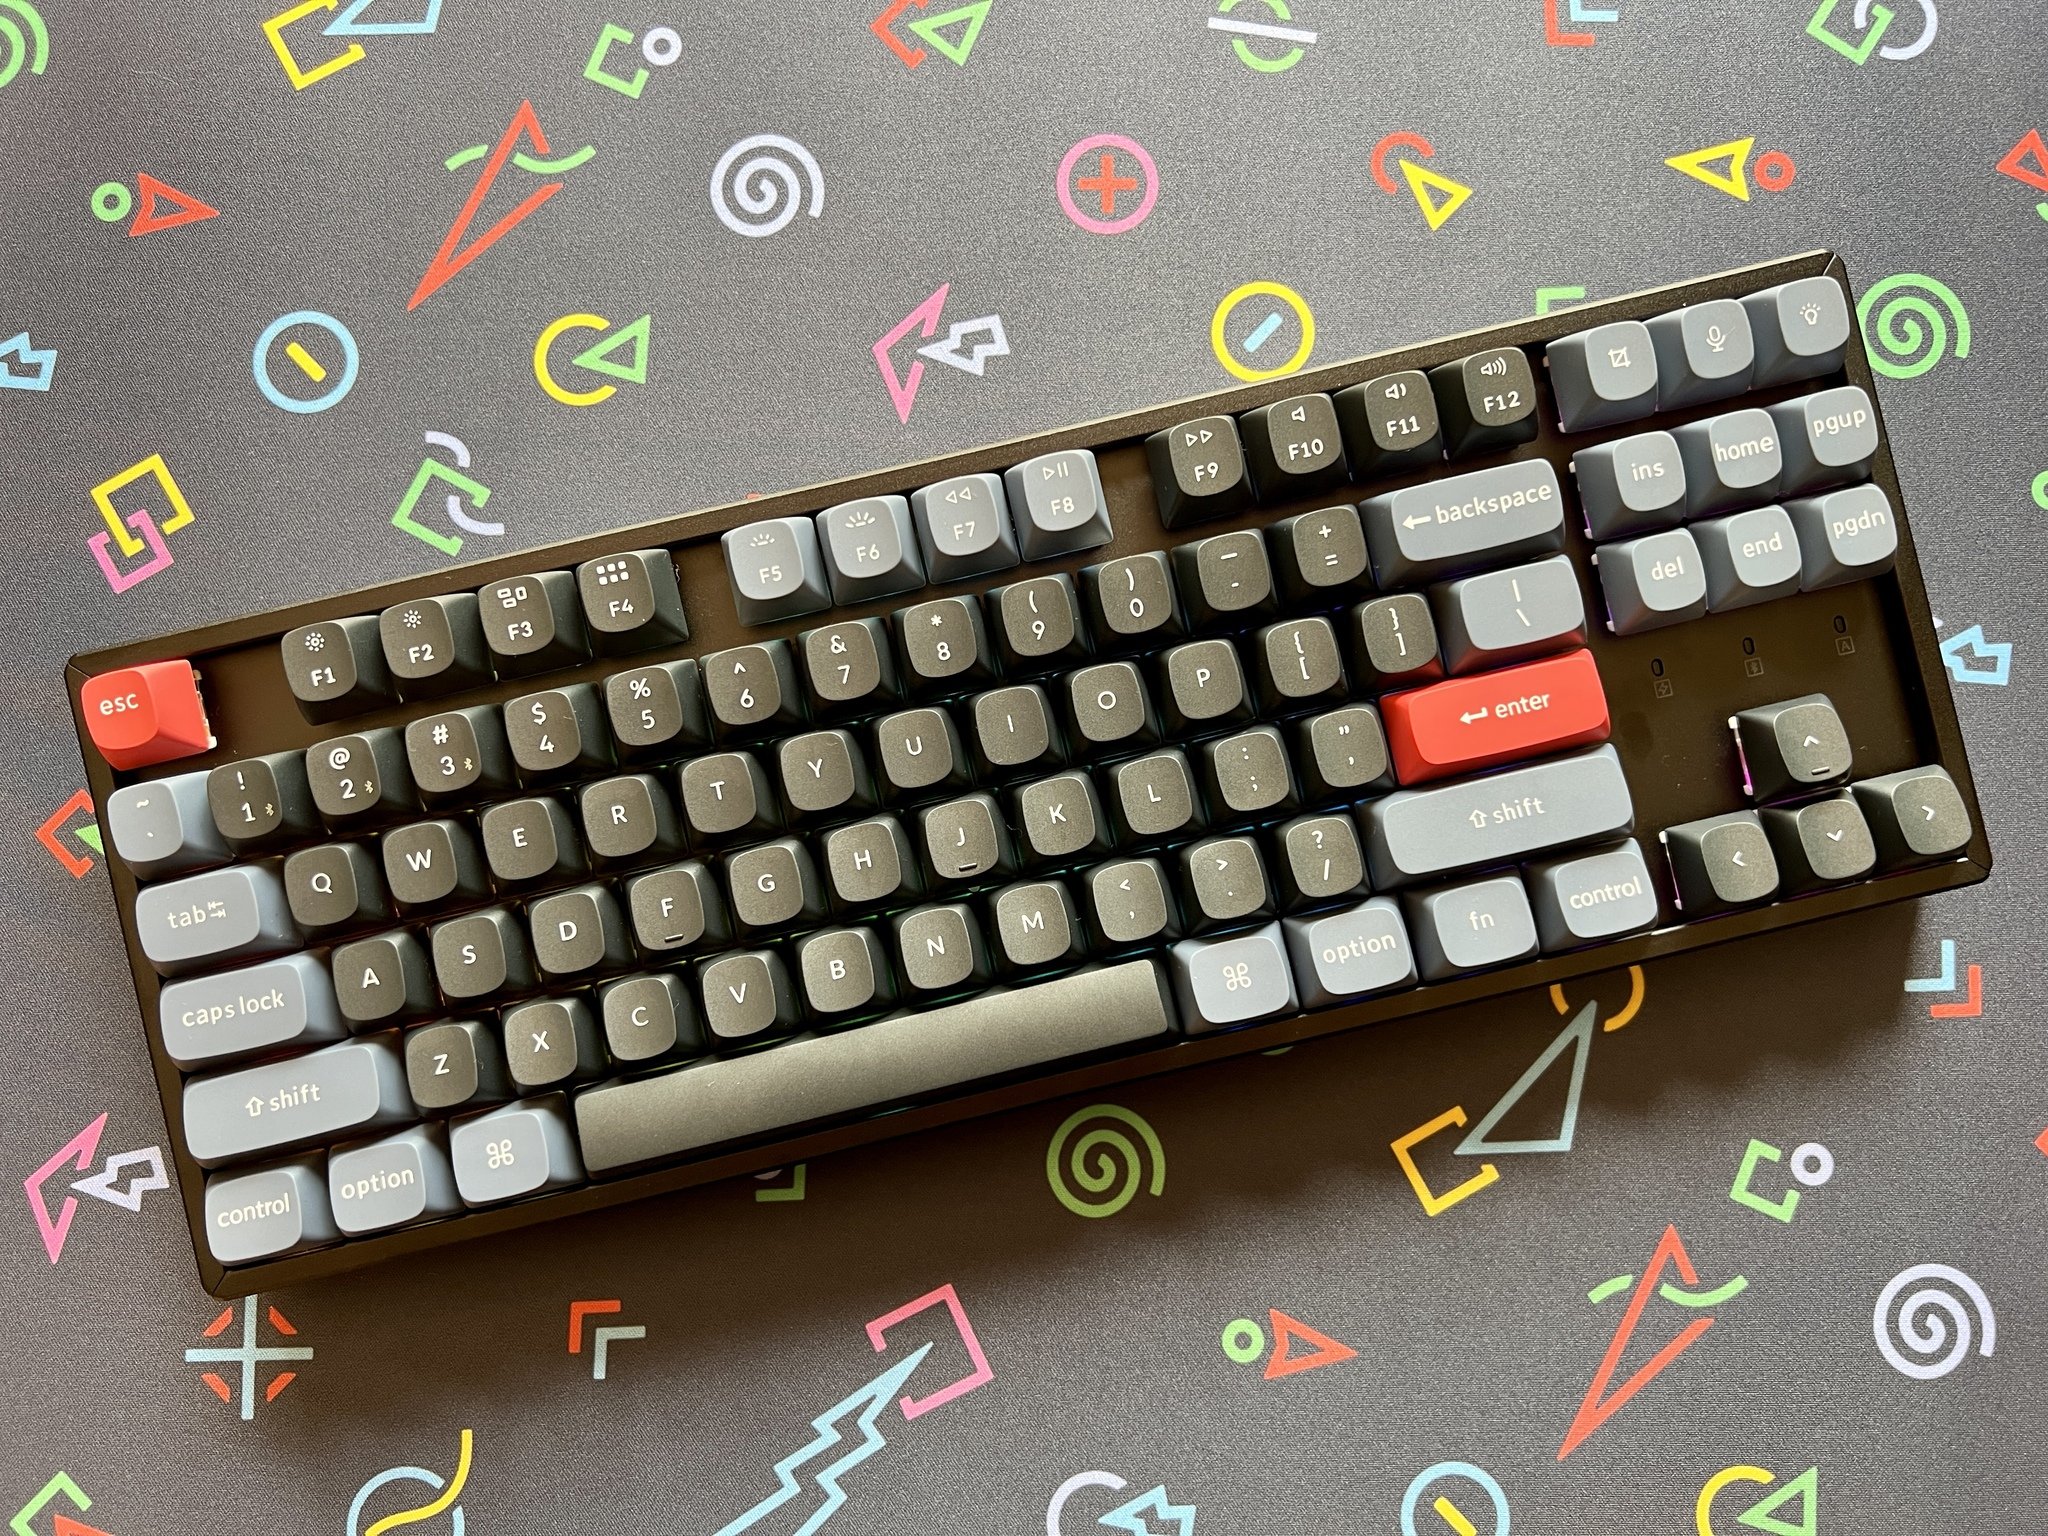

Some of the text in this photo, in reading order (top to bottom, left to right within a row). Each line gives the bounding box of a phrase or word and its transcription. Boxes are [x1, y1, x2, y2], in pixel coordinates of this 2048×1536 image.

[1483, 390, 1521, 414] F12
[1386, 415, 1421, 438] F11
[1813, 409, 1867, 438] pgup
[1288, 438, 1324, 461] F10
[1714, 436, 1775, 463] home
[1194, 461, 1219, 483] F9
[1631, 462, 1665, 482] ins
[1050, 496, 1075, 516] F8
[1435, 484, 1552, 525] backspace
[953, 520, 975, 541] F7
[1318, 524, 1332, 539] +
[1832, 509, 1887, 540] pgdn
[856, 543, 880, 563] F6
[1742, 531, 1783, 558] end
[1324, 553, 1339, 566] =
[1651, 555, 1685, 581] del
[759, 565, 783, 584] F5
[1124, 567, 1135, 592] )
[608, 598, 634, 618] F4
[1028, 590, 1039, 614] (
[1129, 597, 1144, 618] 0
[1388, 607, 1400, 631] }
[1515, 608, 1531, 627] \
[507, 620, 534, 641] F3
[1031, 620, 1046, 641] 9
[830, 634, 848, 654] &
[936, 641, 951, 661] 8
[1293, 630, 1305, 654] {
[1395, 632, 1407, 656] ]
[408, 643, 435, 664] F2
[311, 666, 337, 687] F1
[733, 662, 747, 675] ^
[837, 664, 851, 685] 7
[1196, 668, 1211, 688] P
[1298, 656, 1311, 680] [
[629, 677, 652, 700] %
[740, 688, 755, 709] 6
[99, 693, 139, 716] esc
[1097, 690, 1117, 710] O
[1495, 694, 1550, 719] enter
[531, 701, 547, 726] $
[641, 708, 656, 730] 5
[432, 723, 449, 745] #
[539, 734, 555, 753] 4
[905, 735, 923, 756] U
[329, 747, 351, 770] @
[440, 755, 456, 776] 3
[807, 758, 823, 779] Y
[236, 771, 246, 791] !
[340, 778, 357, 799] 2
[709, 780, 725, 801] T
[1147, 784, 1162, 803] L
[241, 802, 257, 822] 1
[611, 805, 628, 825] R
[1048, 803, 1067, 825] K
[1492, 797, 1545, 824] shift
[512, 827, 528, 848] E
[956, 827, 966, 847] J
[1311, 829, 1324, 850] ?
[405, 848, 432, 872] W
[853, 849, 872, 871] H
[1215, 859, 1229, 871] >
[1323, 858, 1330, 881] /
[311, 872, 333, 894] Q
[757, 873, 776, 893] G
[1119, 878, 1131, 891] <
[1569, 875, 1643, 910] control
[167, 904, 207, 929] tab
[660, 897, 674, 918] F
[1021, 910, 1045, 934] M
[1469, 910, 1495, 931] fn
[558, 921, 578, 942] D
[462, 944, 477, 965] S
[926, 935, 945, 957] N
[1322, 934, 1397, 964] option
[362, 967, 380, 989] A
[829, 959, 846, 980] B
[728, 982, 747, 1004] V
[182, 988, 285, 1027] caps lock
[631, 1006, 649, 1027] C
[532, 1030, 550, 1053] X
[433, 1053, 450, 1076] Z
[269, 1083, 321, 1112] shift
[340, 1169, 415, 1200] option
[217, 1192, 290, 1228] control
